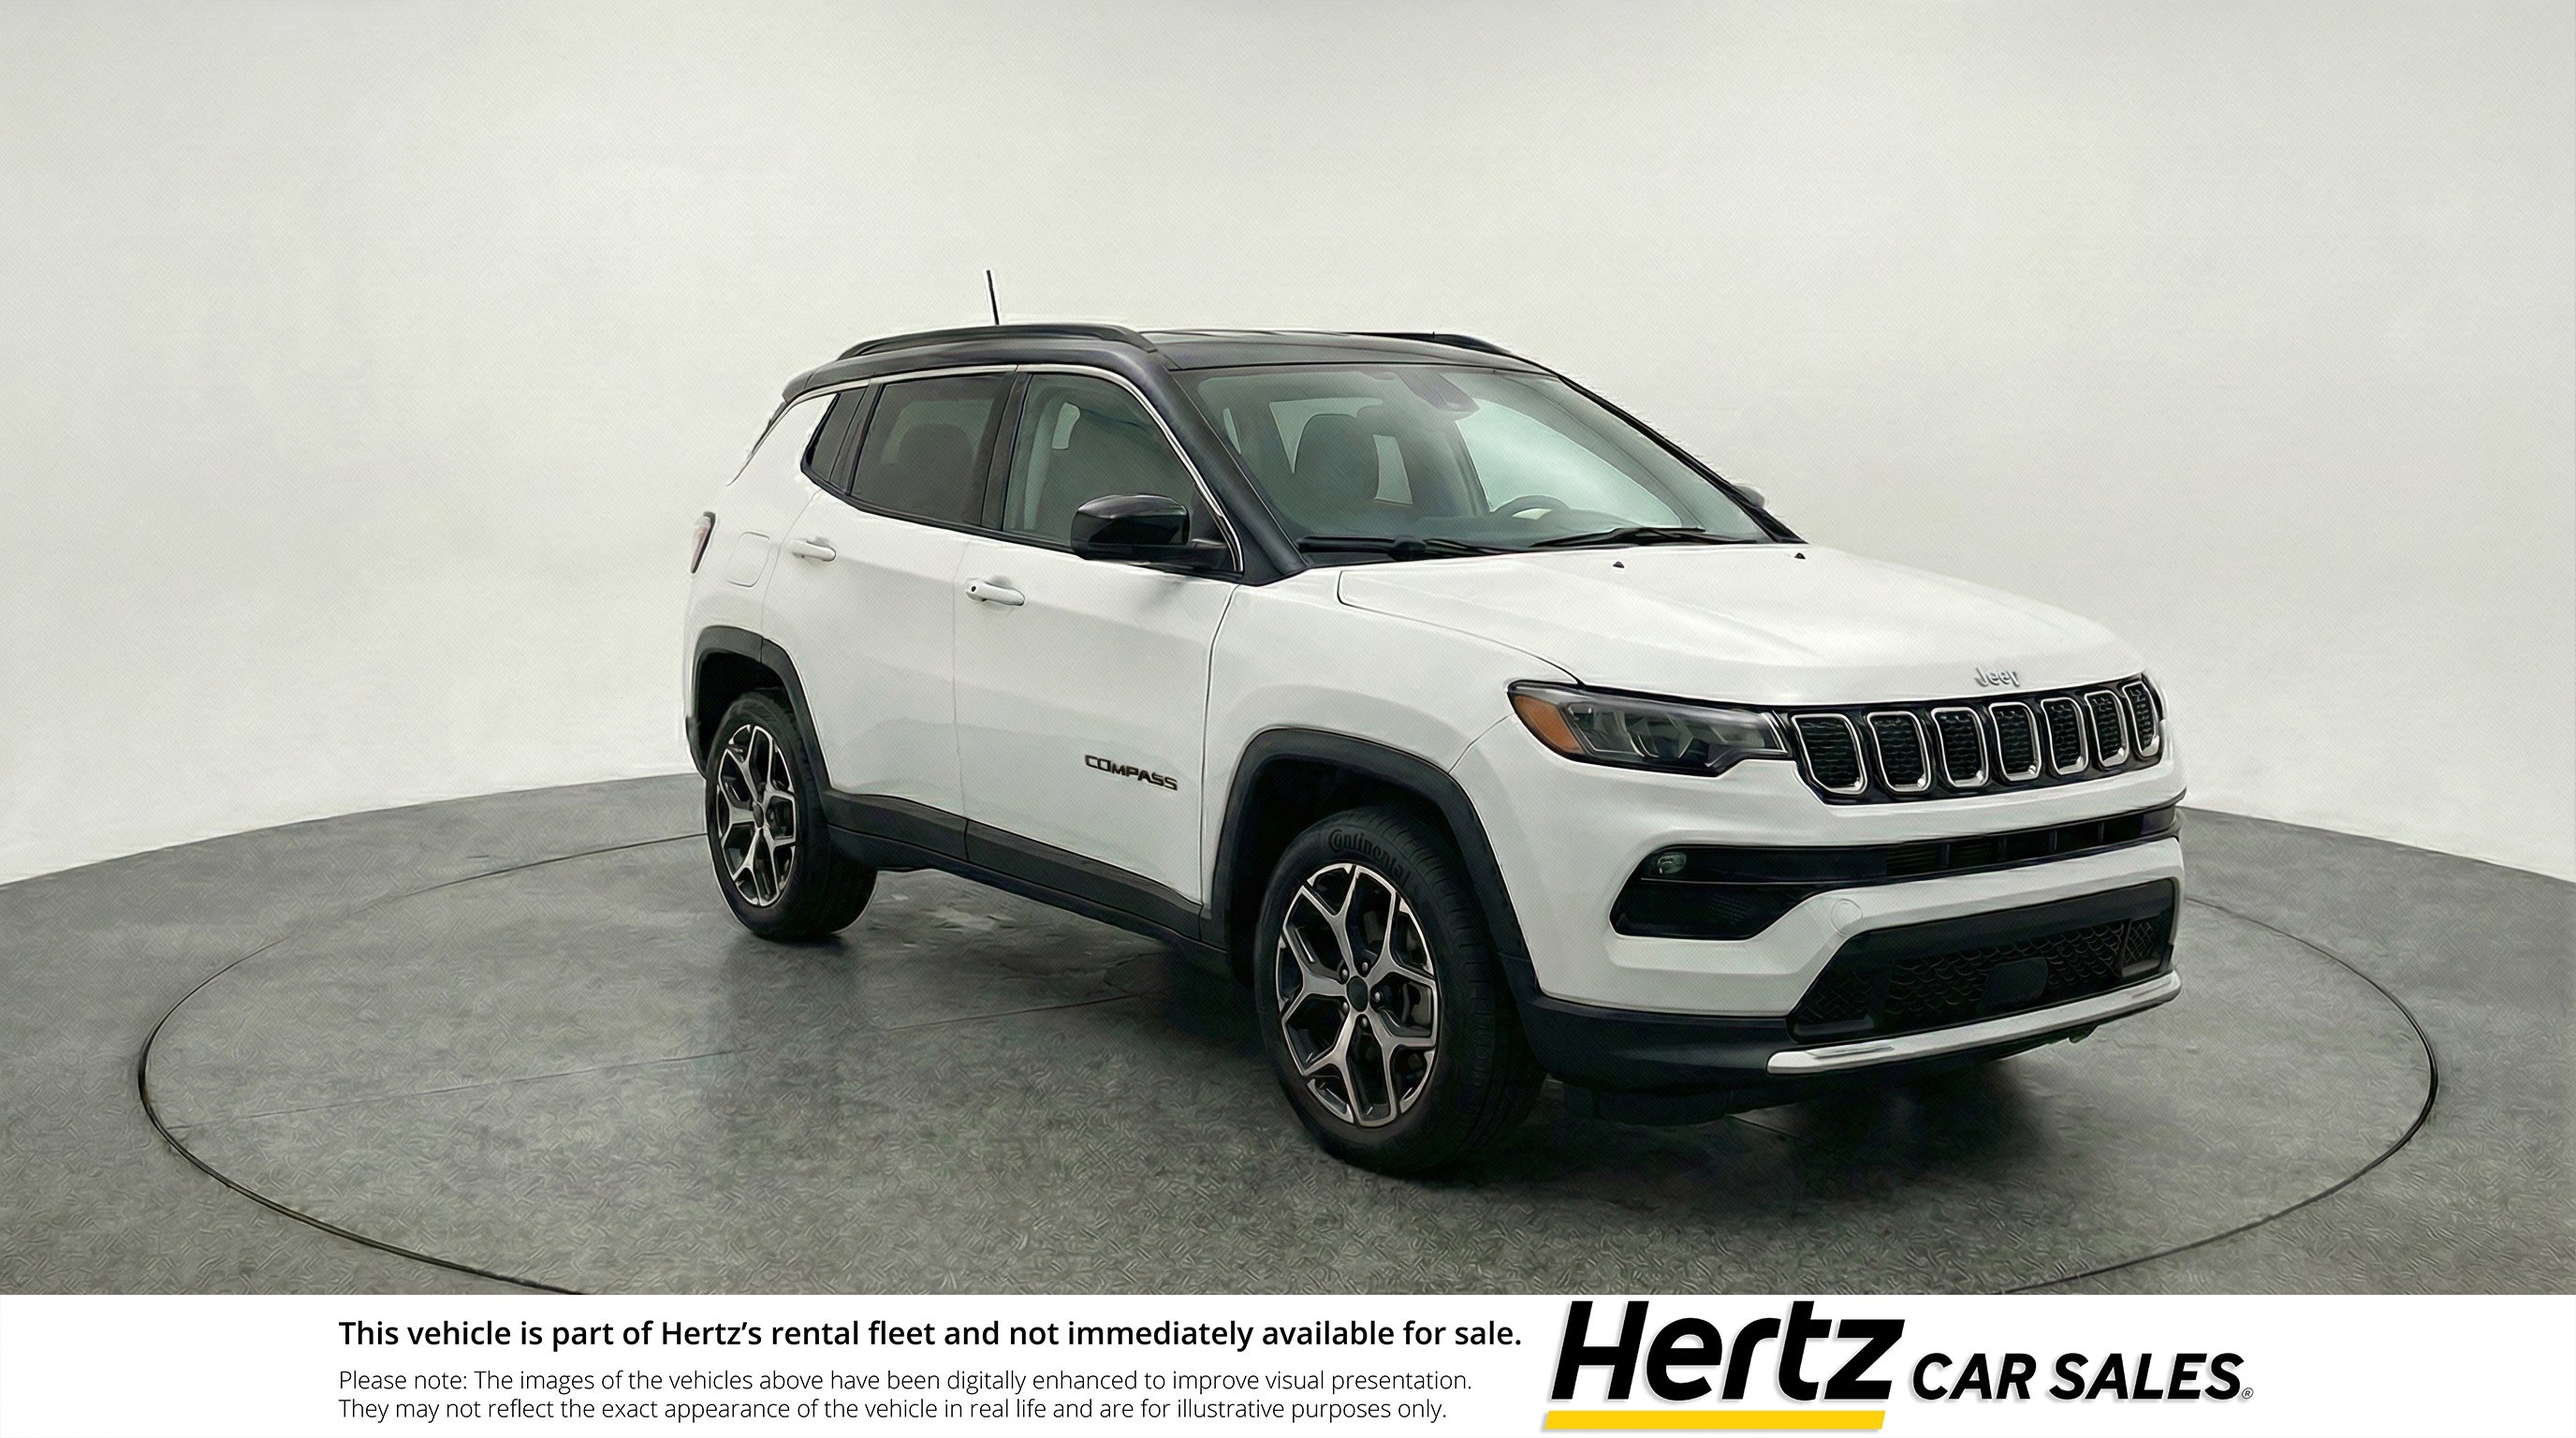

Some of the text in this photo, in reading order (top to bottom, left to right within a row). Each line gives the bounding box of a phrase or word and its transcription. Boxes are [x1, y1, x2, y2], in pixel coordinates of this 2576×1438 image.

[1973, 666, 2020, 688] Jeep
[1084, 754, 1178, 791] COMPASS
[1327, 828, 1412, 887] Continental
